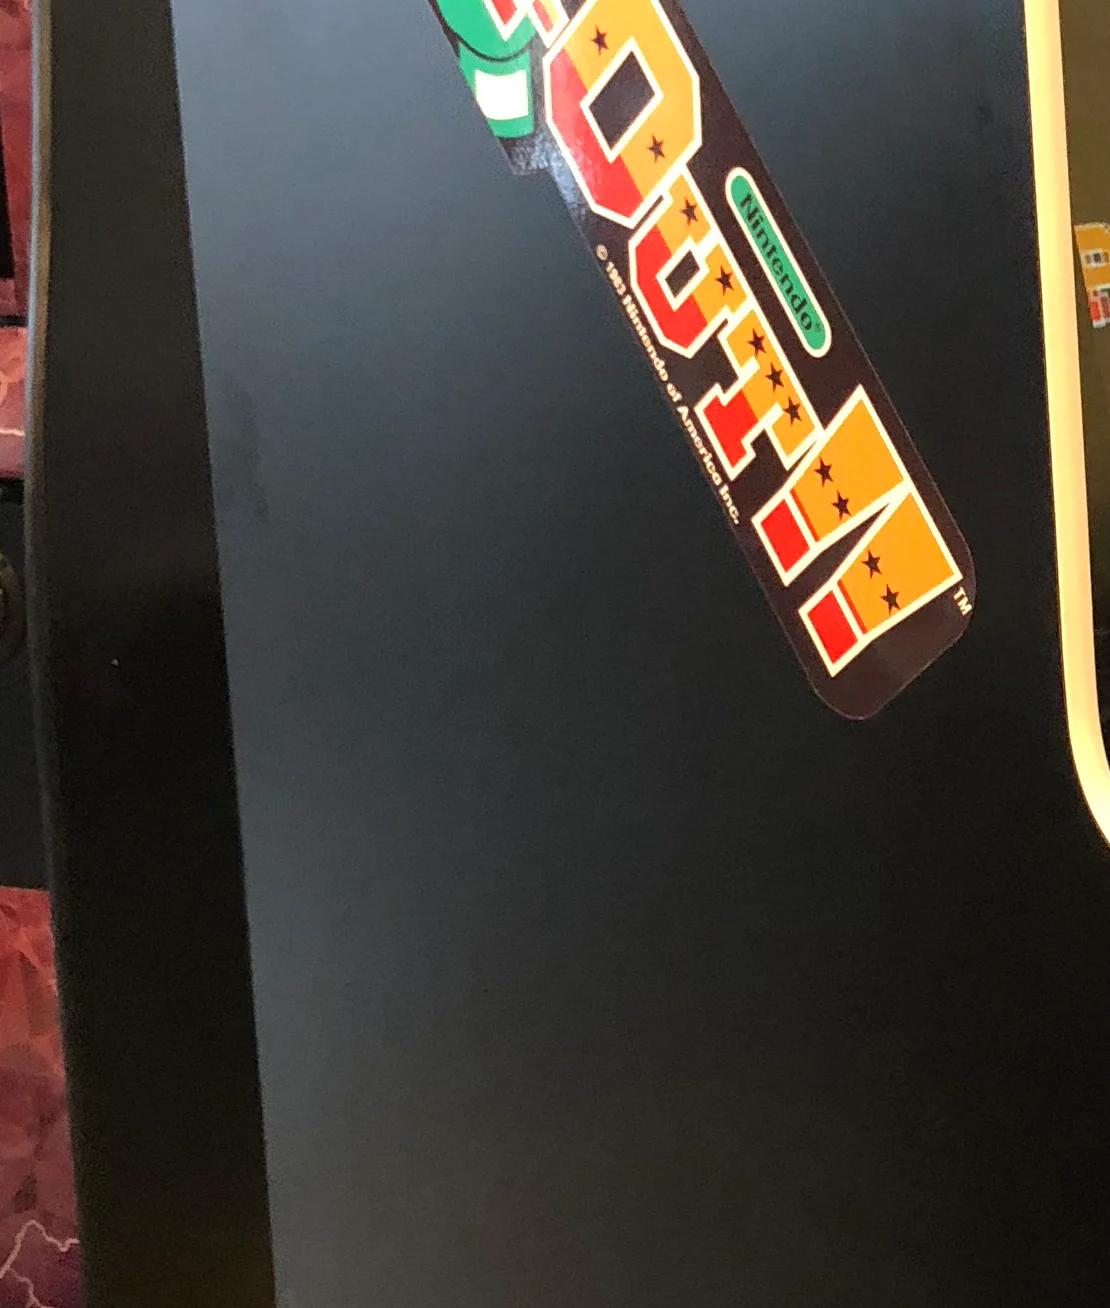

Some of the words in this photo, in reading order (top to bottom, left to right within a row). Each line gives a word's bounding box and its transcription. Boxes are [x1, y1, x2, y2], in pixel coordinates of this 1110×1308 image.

[622, 294, 669, 382] Nintendo
[666, 382, 683, 403] of
[676, 405, 723, 486] America
[718, 484, 740, 525] Inc.
